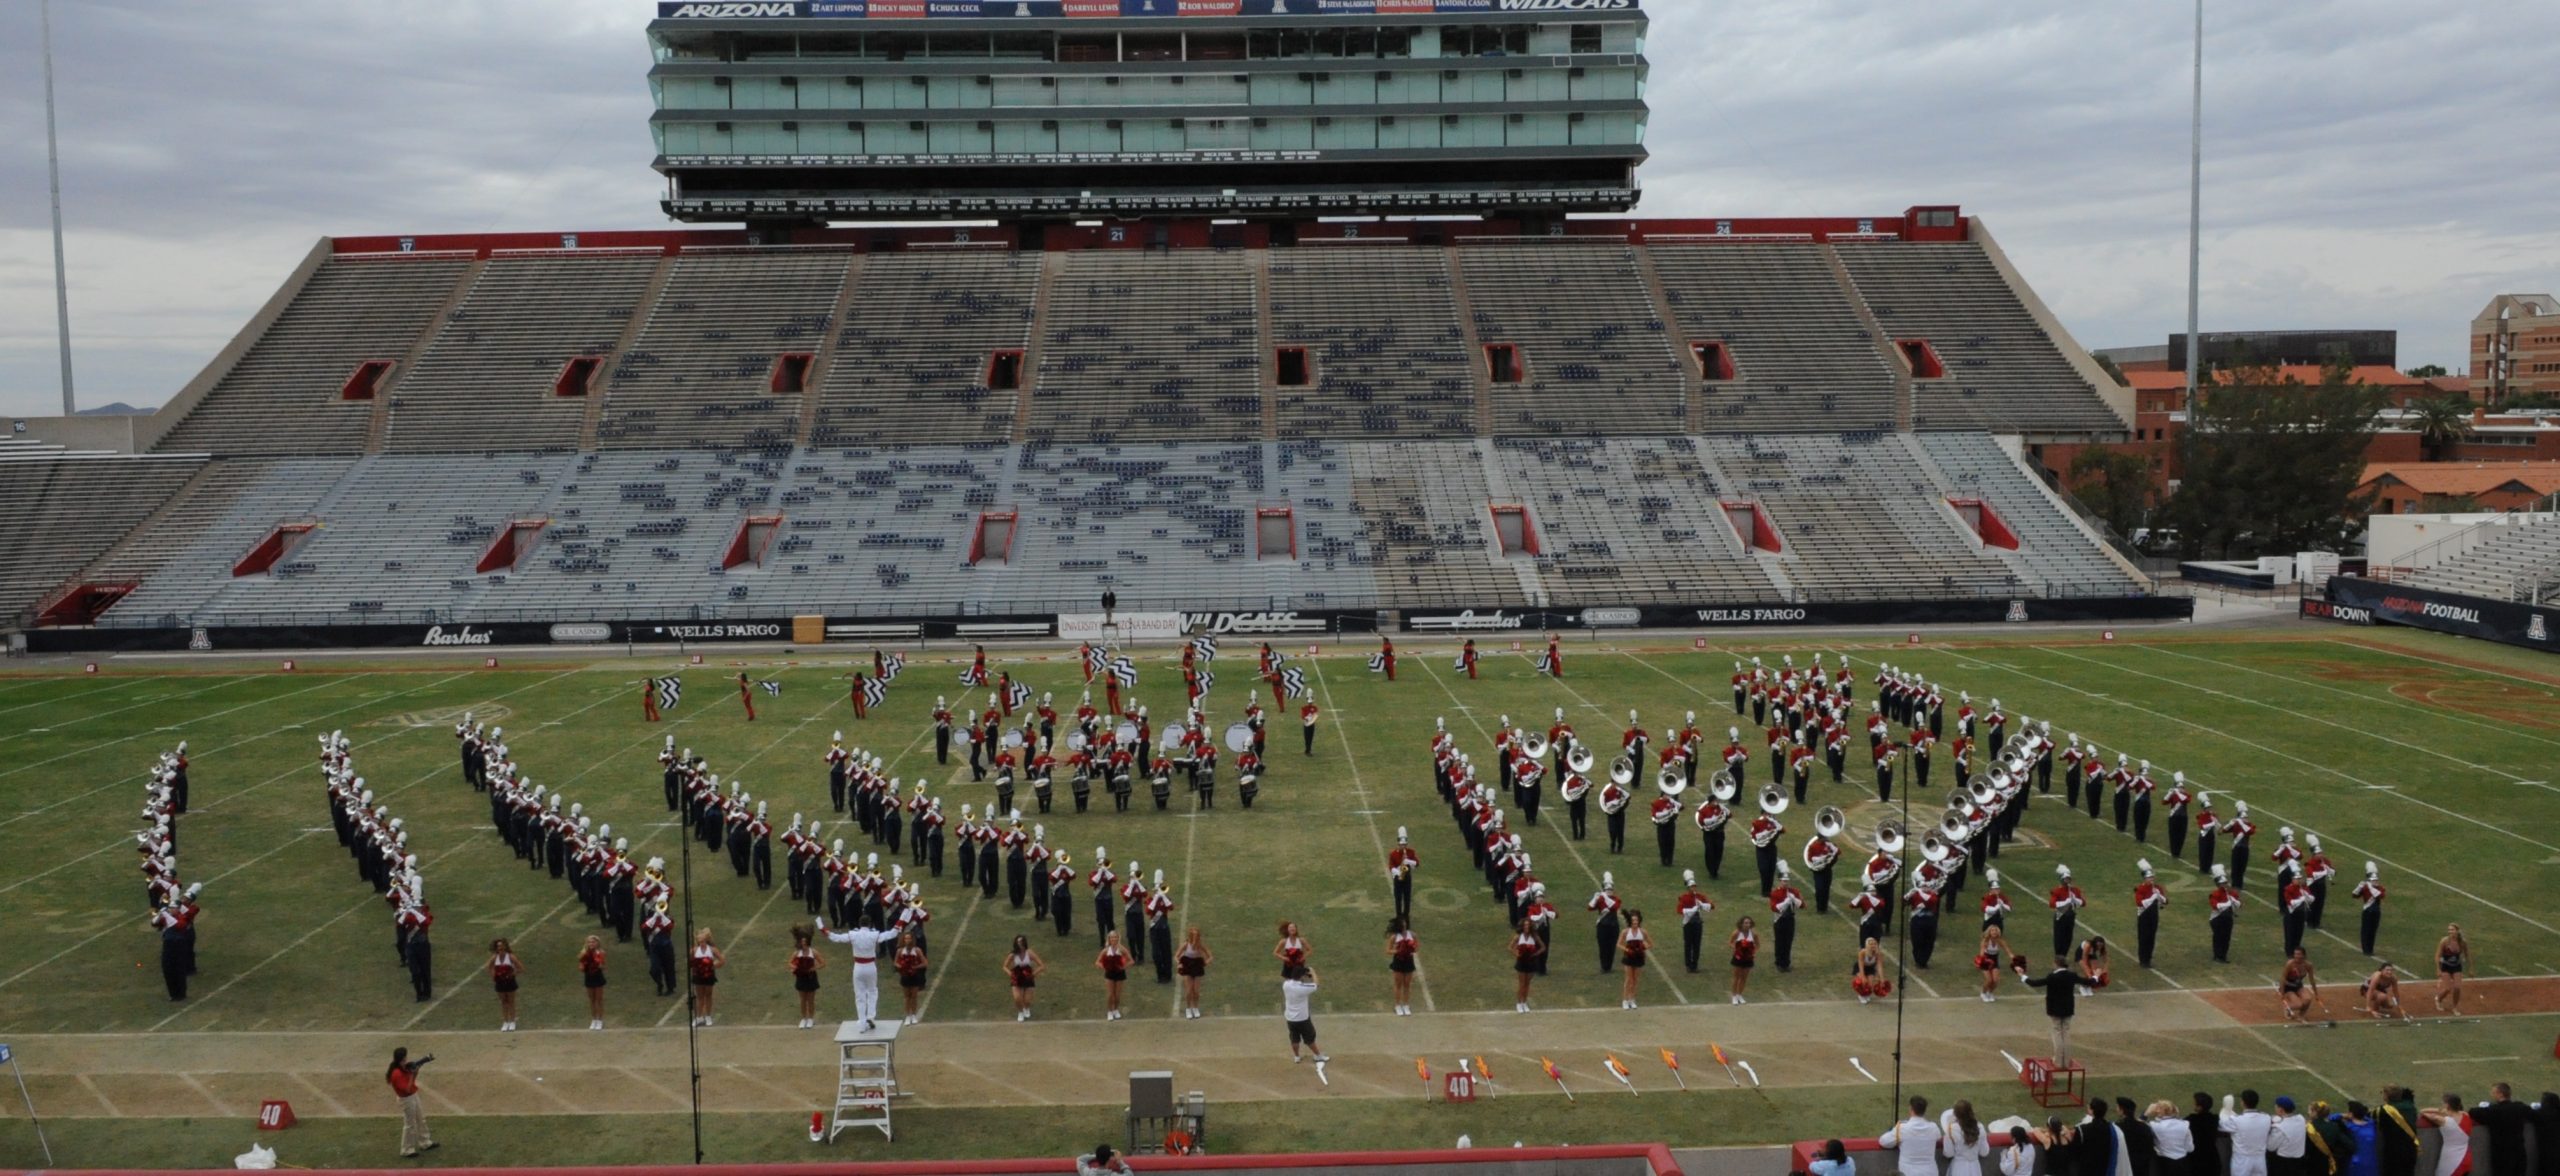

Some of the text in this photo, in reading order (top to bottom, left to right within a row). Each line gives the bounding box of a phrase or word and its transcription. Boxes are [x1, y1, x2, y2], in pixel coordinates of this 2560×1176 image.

[878, 4, 898, 12] RICKY
[899, 4, 925, 12] HUNLEY
[936, 4, 960, 12] CHUCK
[960, 4, 980, 12] CECIL
[1068, 4, 1098, 12] DARRYLL
[1098, 4, 1119, 12] LEWIS
[1202, 2, 1235, 10] WALDROP
[1498, 0, 1631, 10] WILDCATS
[671, 3, 796, 18] ARIZONA
[1344, 229, 1358, 238] 22
[1717, 226, 1730, 235] 24
[1858, 225, 1872, 234] 25
[955, 234, 969, 243] 20
[1111, 231, 1123, 241] 21
[563, 240, 576, 249] 18
[748, 237, 760, 245] 19
[402, 243, 412, 252] 17
[14, 423, 26, 431] 16
[1696, 609, 1806, 621] WELLS FARGO
[2304, 602, 2370, 623] BEAR DOWN
[2422, 602, 2480, 624] FOOTBALL
[1061, 620, 1099, 632] UNIVERSITY
[1142, 619, 1162, 630] BAND
[1162, 619, 1177, 630] DAY
[422, 625, 493, 645] Bashas'
[668, 624, 780, 637] WELLS FARGO
[1449, 1075, 1470, 1098] 40
[260, 1103, 282, 1127] 40
